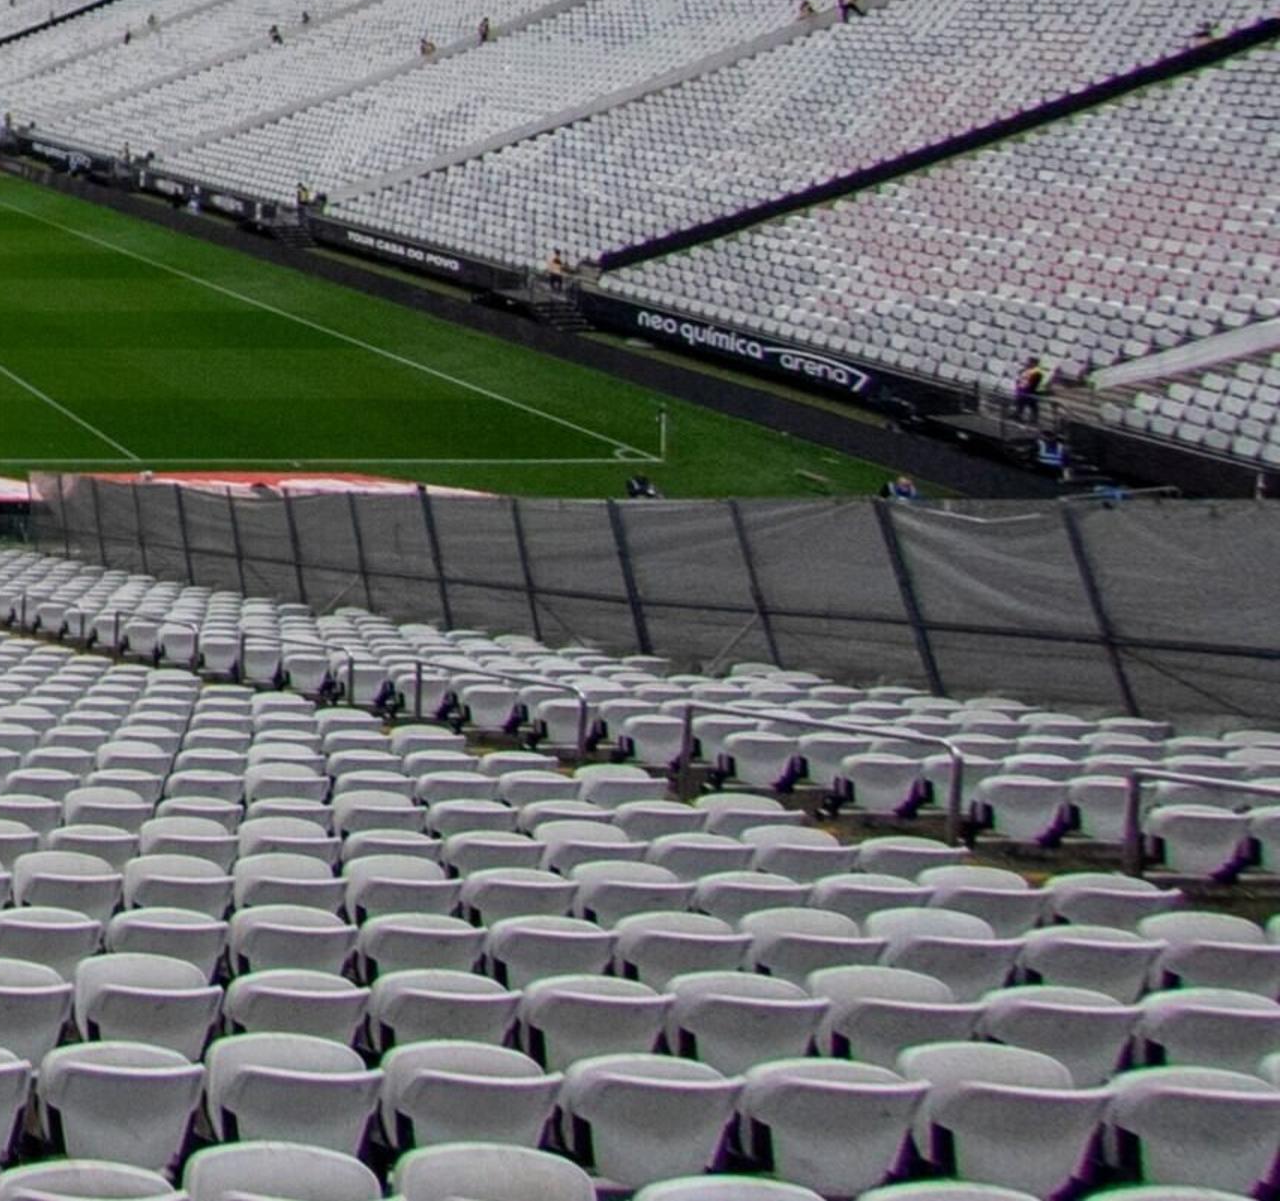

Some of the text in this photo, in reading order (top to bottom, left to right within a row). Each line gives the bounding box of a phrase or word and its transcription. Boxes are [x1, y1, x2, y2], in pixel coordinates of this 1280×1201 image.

[406, 248, 424, 261] DO
[425, 253, 460, 271] POVO
[637, 311, 848, 385] neo química arena
